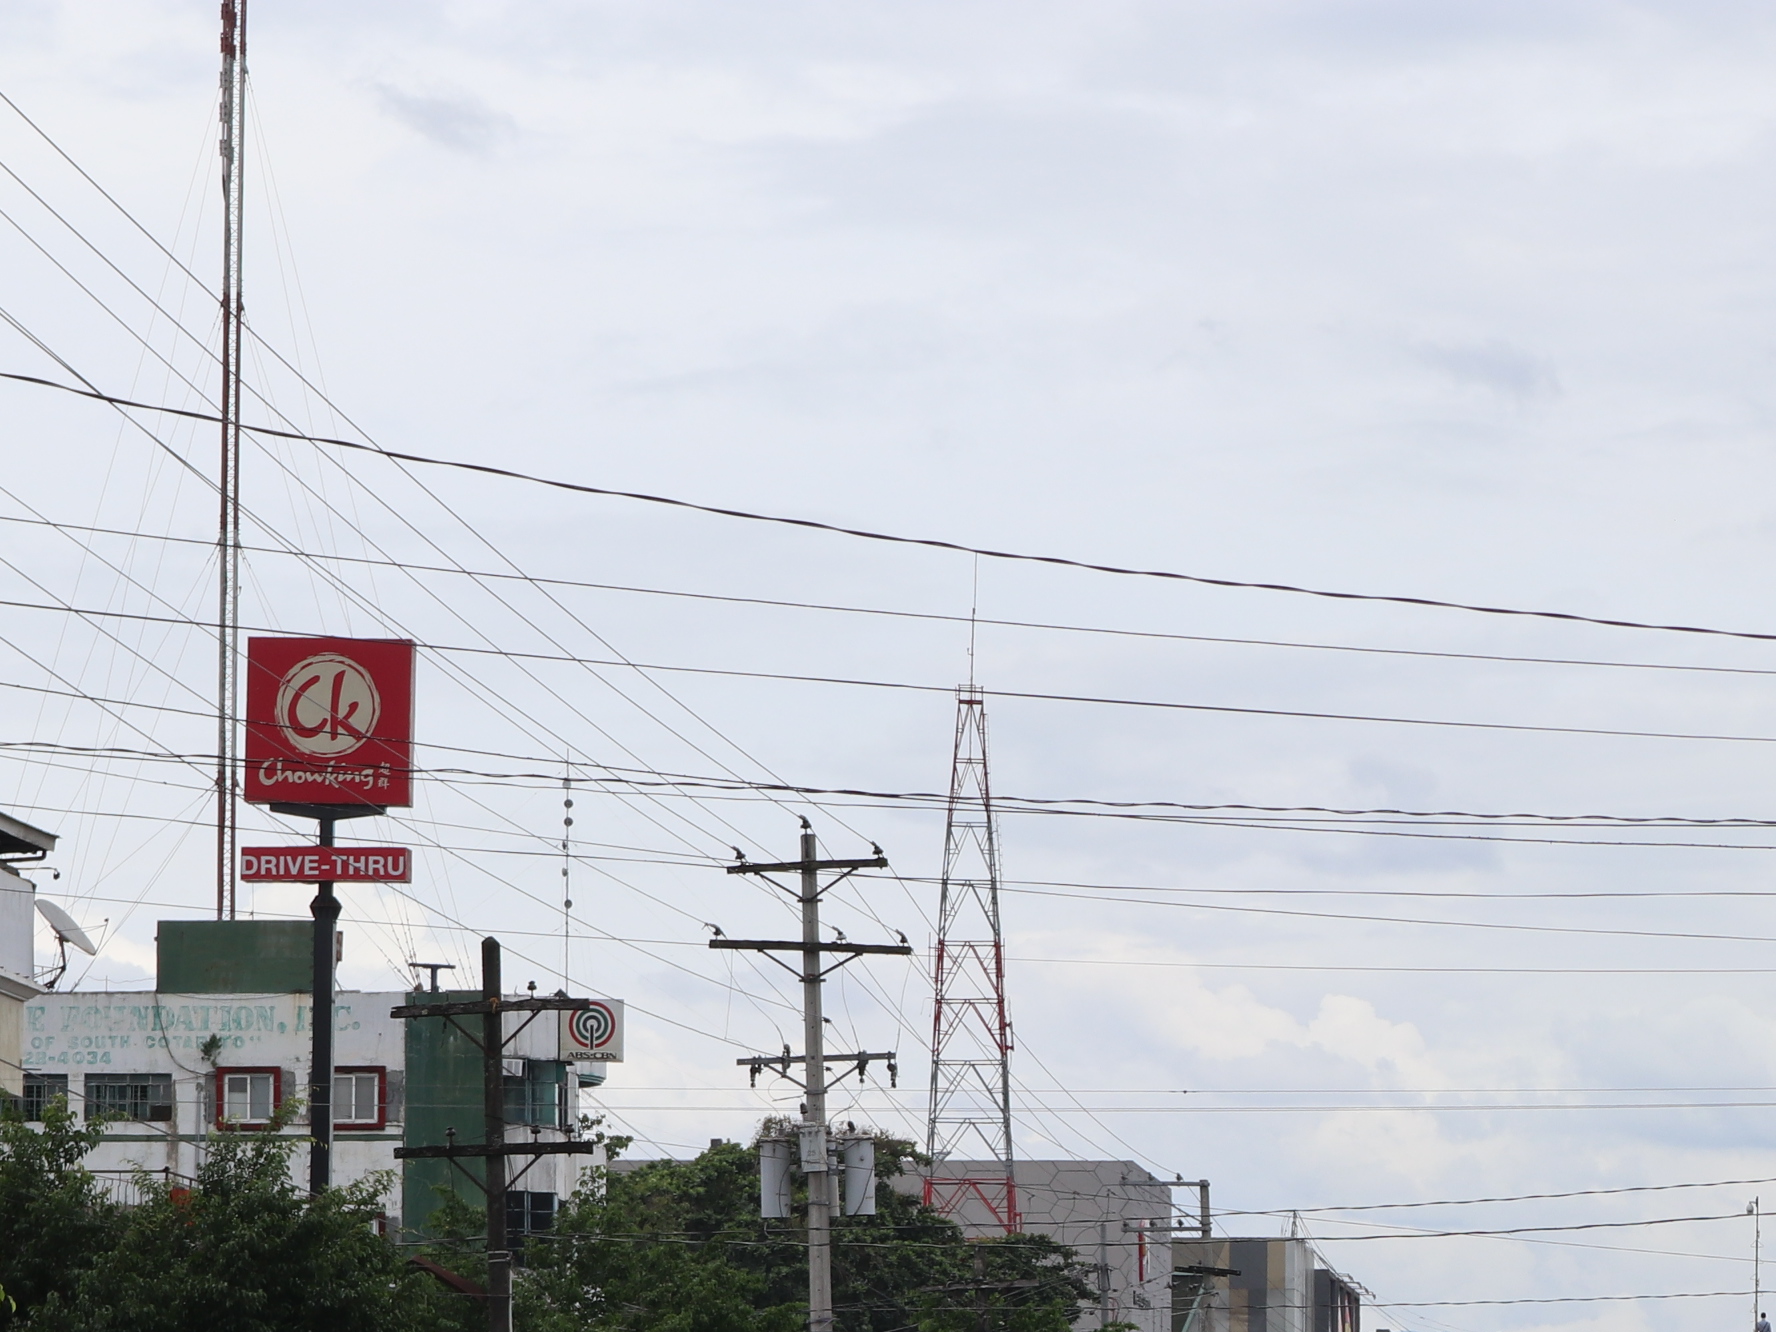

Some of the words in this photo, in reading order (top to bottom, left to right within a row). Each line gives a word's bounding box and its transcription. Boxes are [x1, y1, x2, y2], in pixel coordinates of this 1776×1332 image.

[258, 757, 375, 790] Chowking
[241, 854, 405, 876] DRIVE-THRU
[294, 1004, 361, 1033] IC.
[30, 1036, 55, 1050] OF
[67, 1035, 130, 1050] SOUTH
